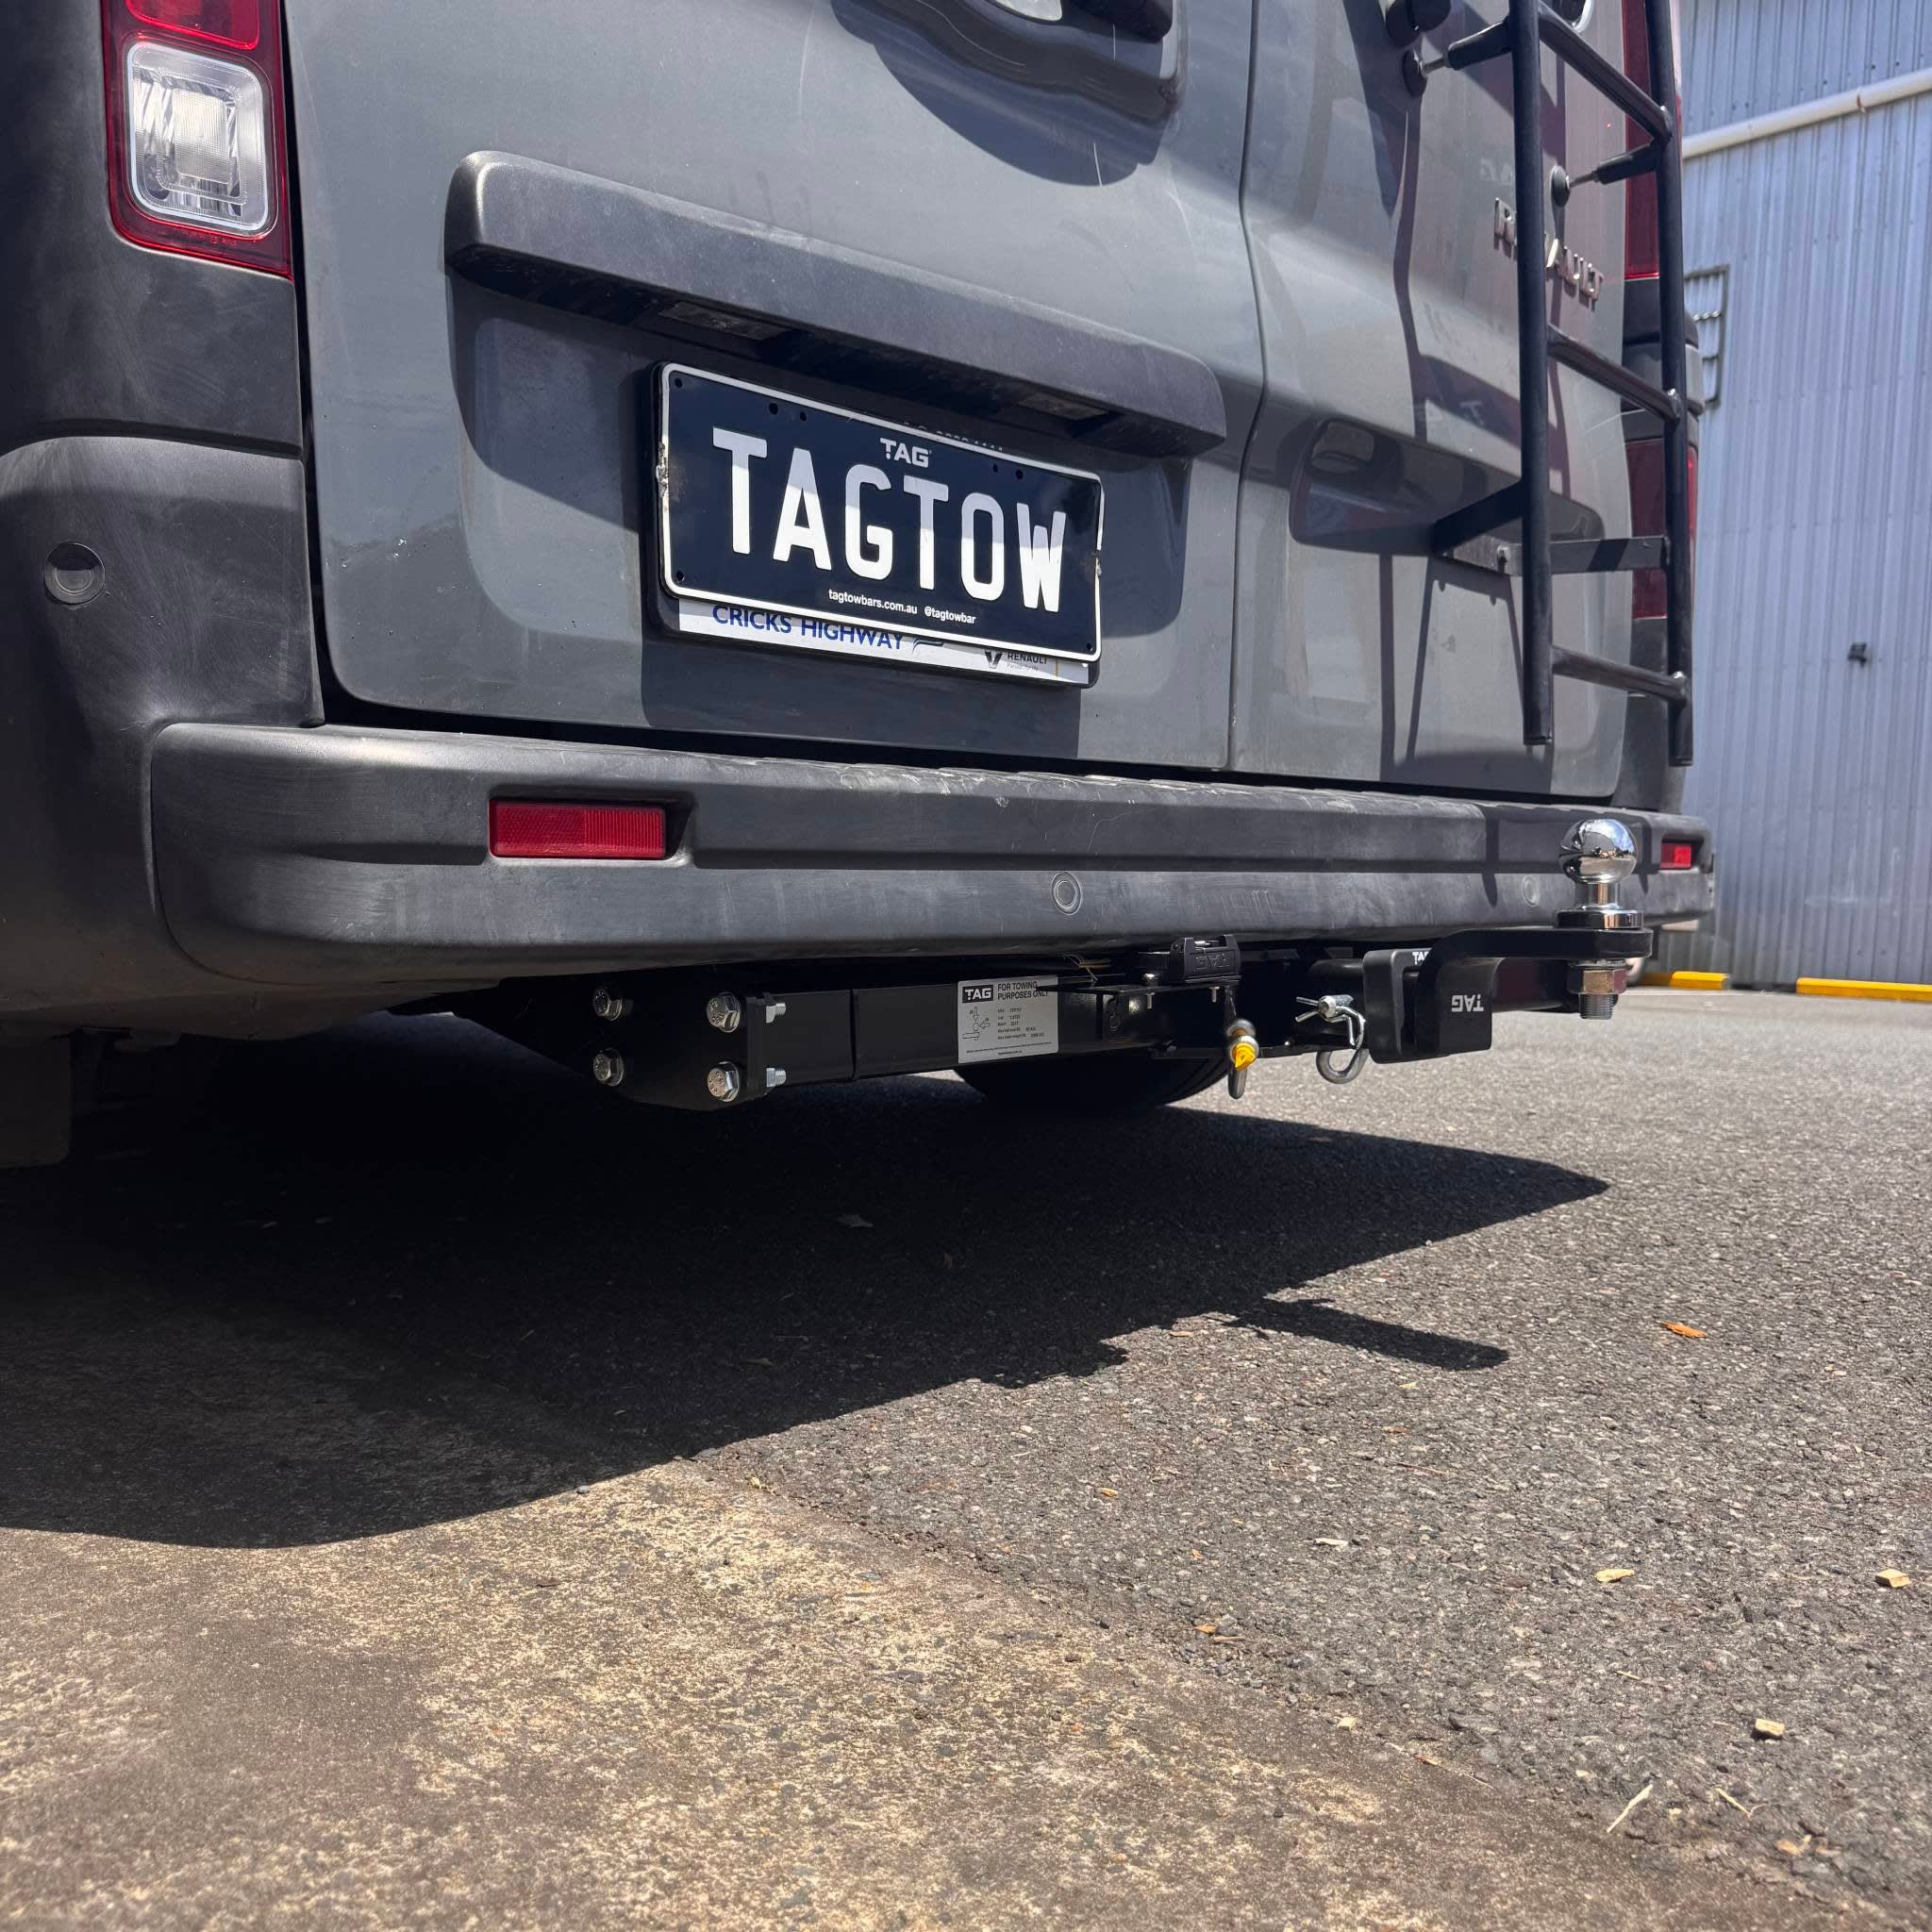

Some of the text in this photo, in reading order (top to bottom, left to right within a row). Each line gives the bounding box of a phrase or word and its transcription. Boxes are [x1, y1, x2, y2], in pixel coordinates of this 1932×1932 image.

[880, 437, 929, 468] TAG
[713, 427, 1066, 612] TAGTOW
[828, 589, 976, 625] tagtowbars.com.au @tagtowbar
[712, 605, 904, 650] CRICKS HIGHWAY
[1008, 651, 1048, 665] RENAULT
[964, 988, 992, 1000] TAG
[997, 981, 1038, 991] FOR TOWING
[997, 991, 1032, 1000] PURPOSES
[1451, 993, 1484, 1012] TAG
